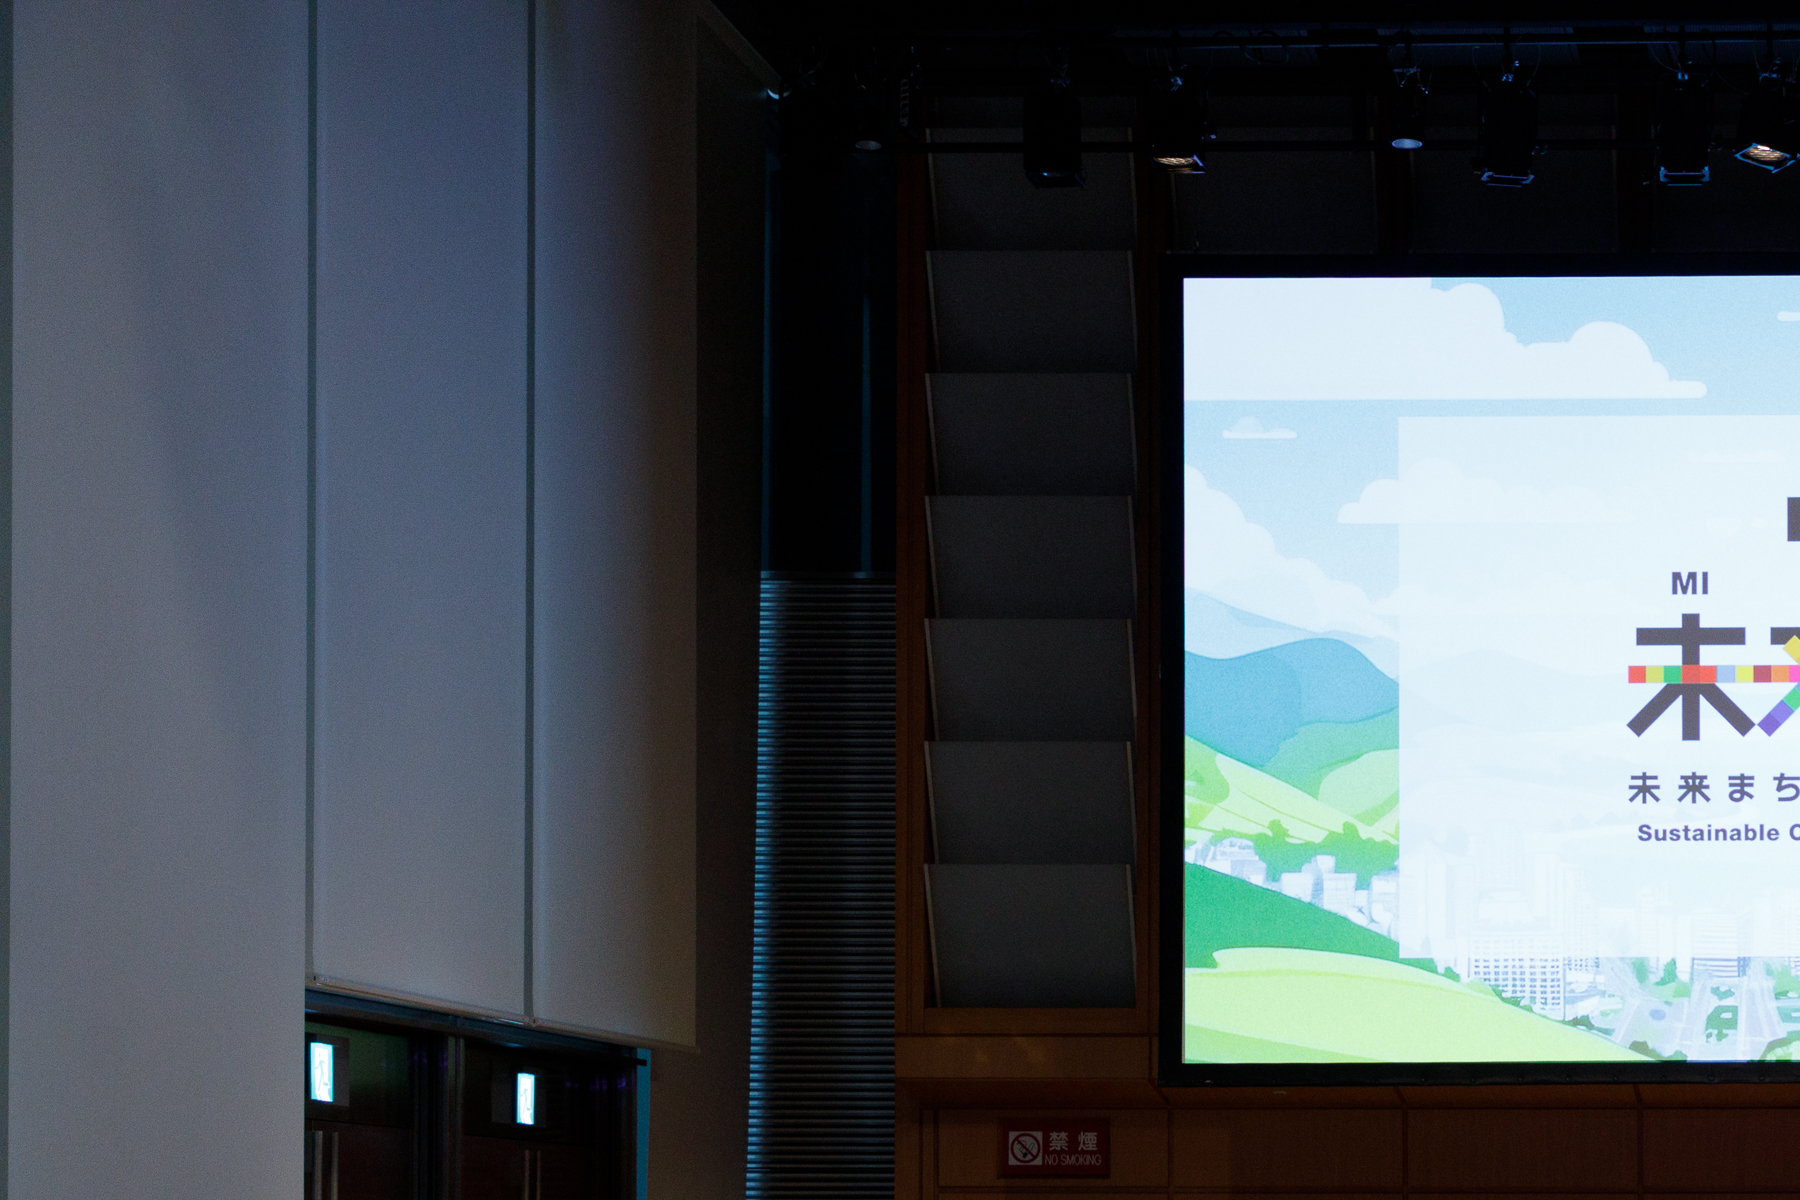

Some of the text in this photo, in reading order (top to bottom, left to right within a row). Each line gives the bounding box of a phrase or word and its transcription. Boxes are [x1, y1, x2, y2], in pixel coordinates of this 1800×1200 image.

[1671, 571, 1709, 595] MI
[1637, 823, 1780, 842] Sustainable
[1049, 1131, 1098, 1151] 禁煙
[1045, 1154, 1102, 1165] NO SMOKING
